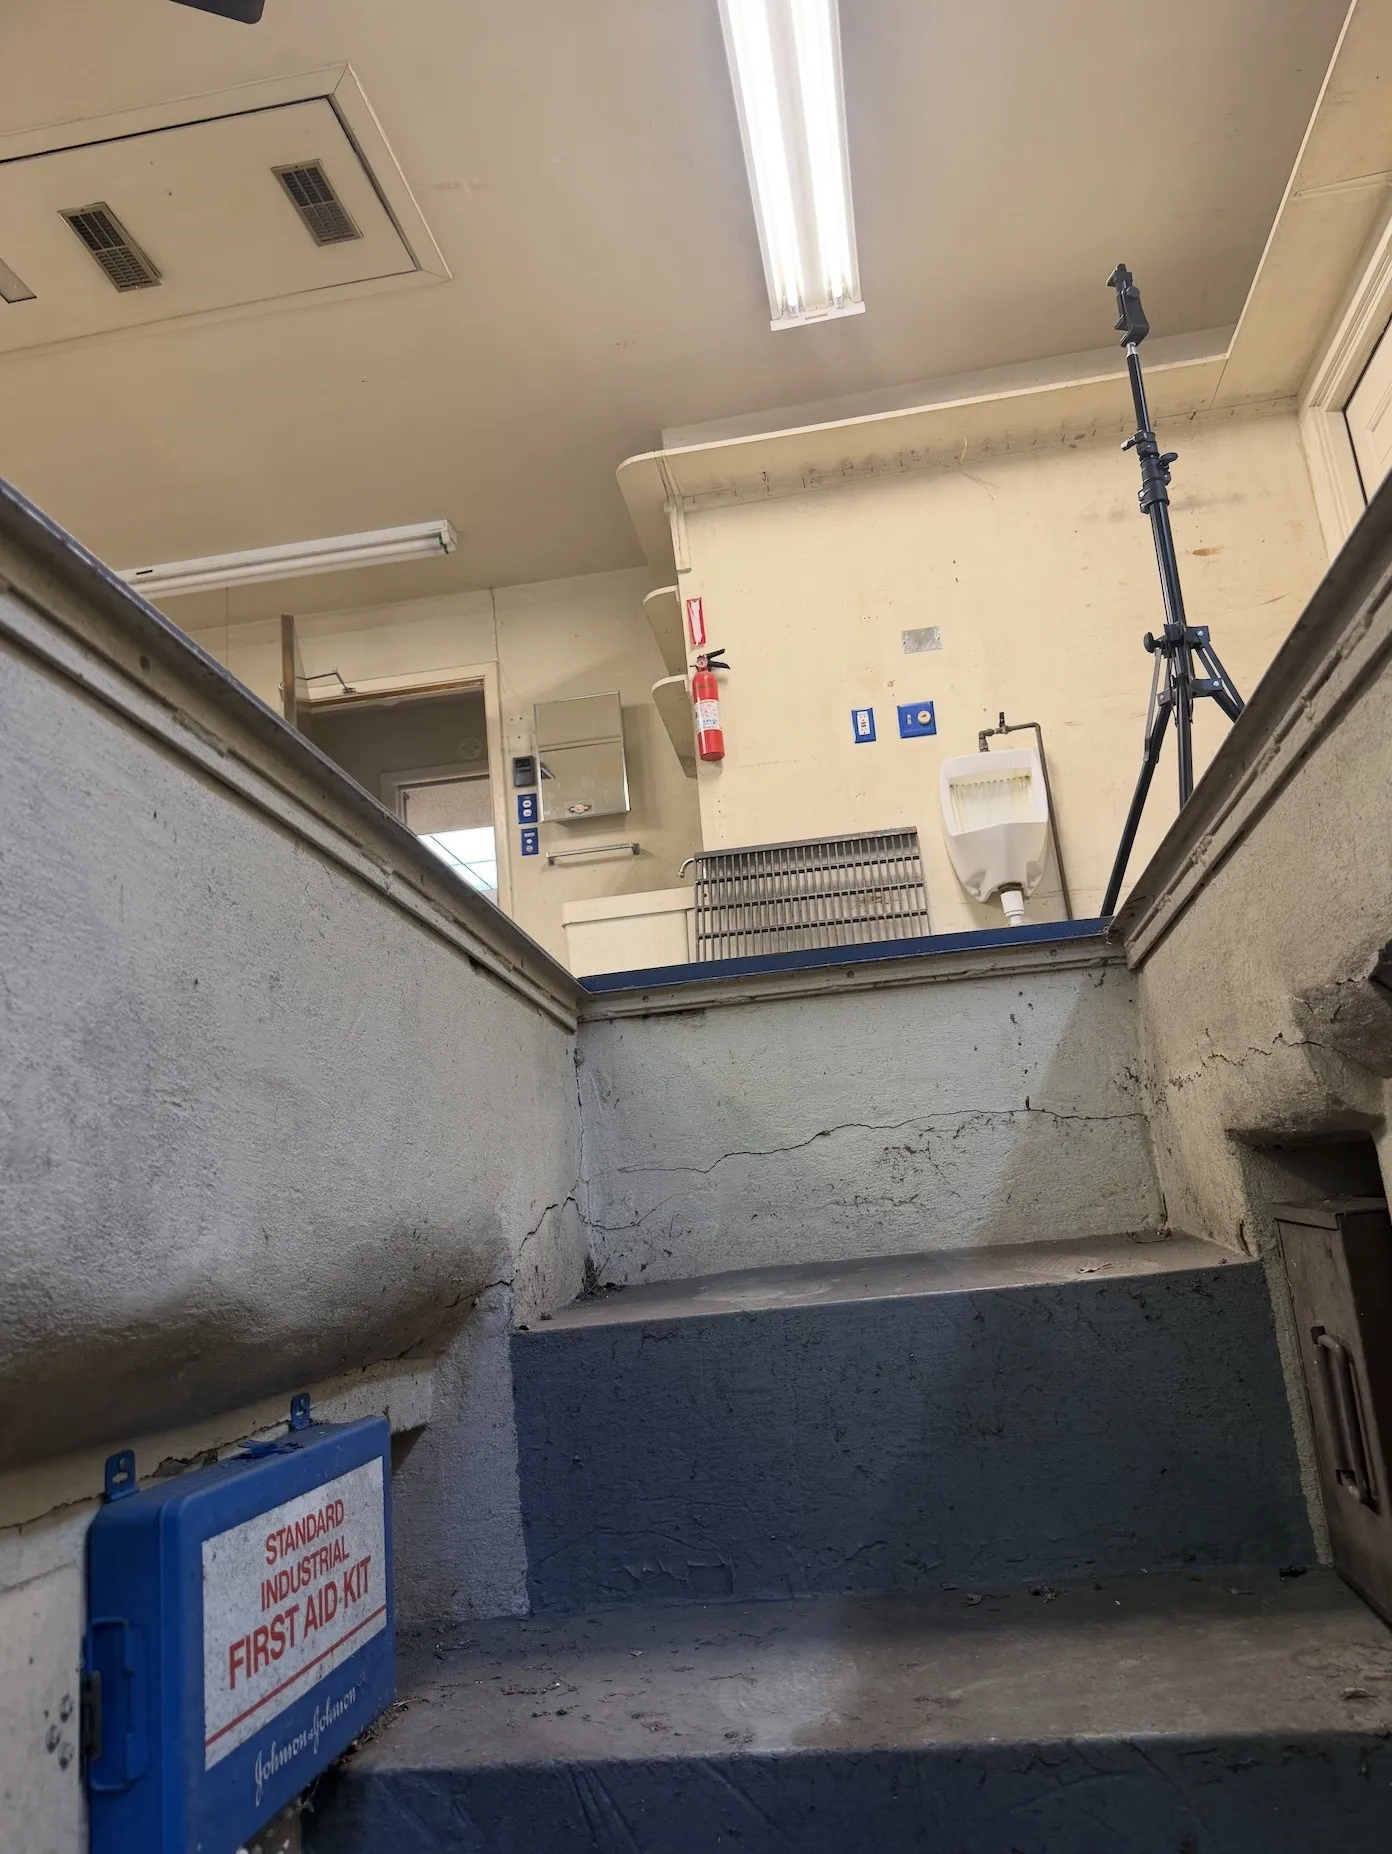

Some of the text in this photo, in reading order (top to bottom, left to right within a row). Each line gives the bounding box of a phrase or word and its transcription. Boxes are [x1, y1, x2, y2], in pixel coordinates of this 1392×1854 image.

[265, 1499, 344, 1565] STANDARD
[261, 1535, 349, 1612] INDUSTRIAL
[229, 1555, 372, 1690] FIRST AID KIT
